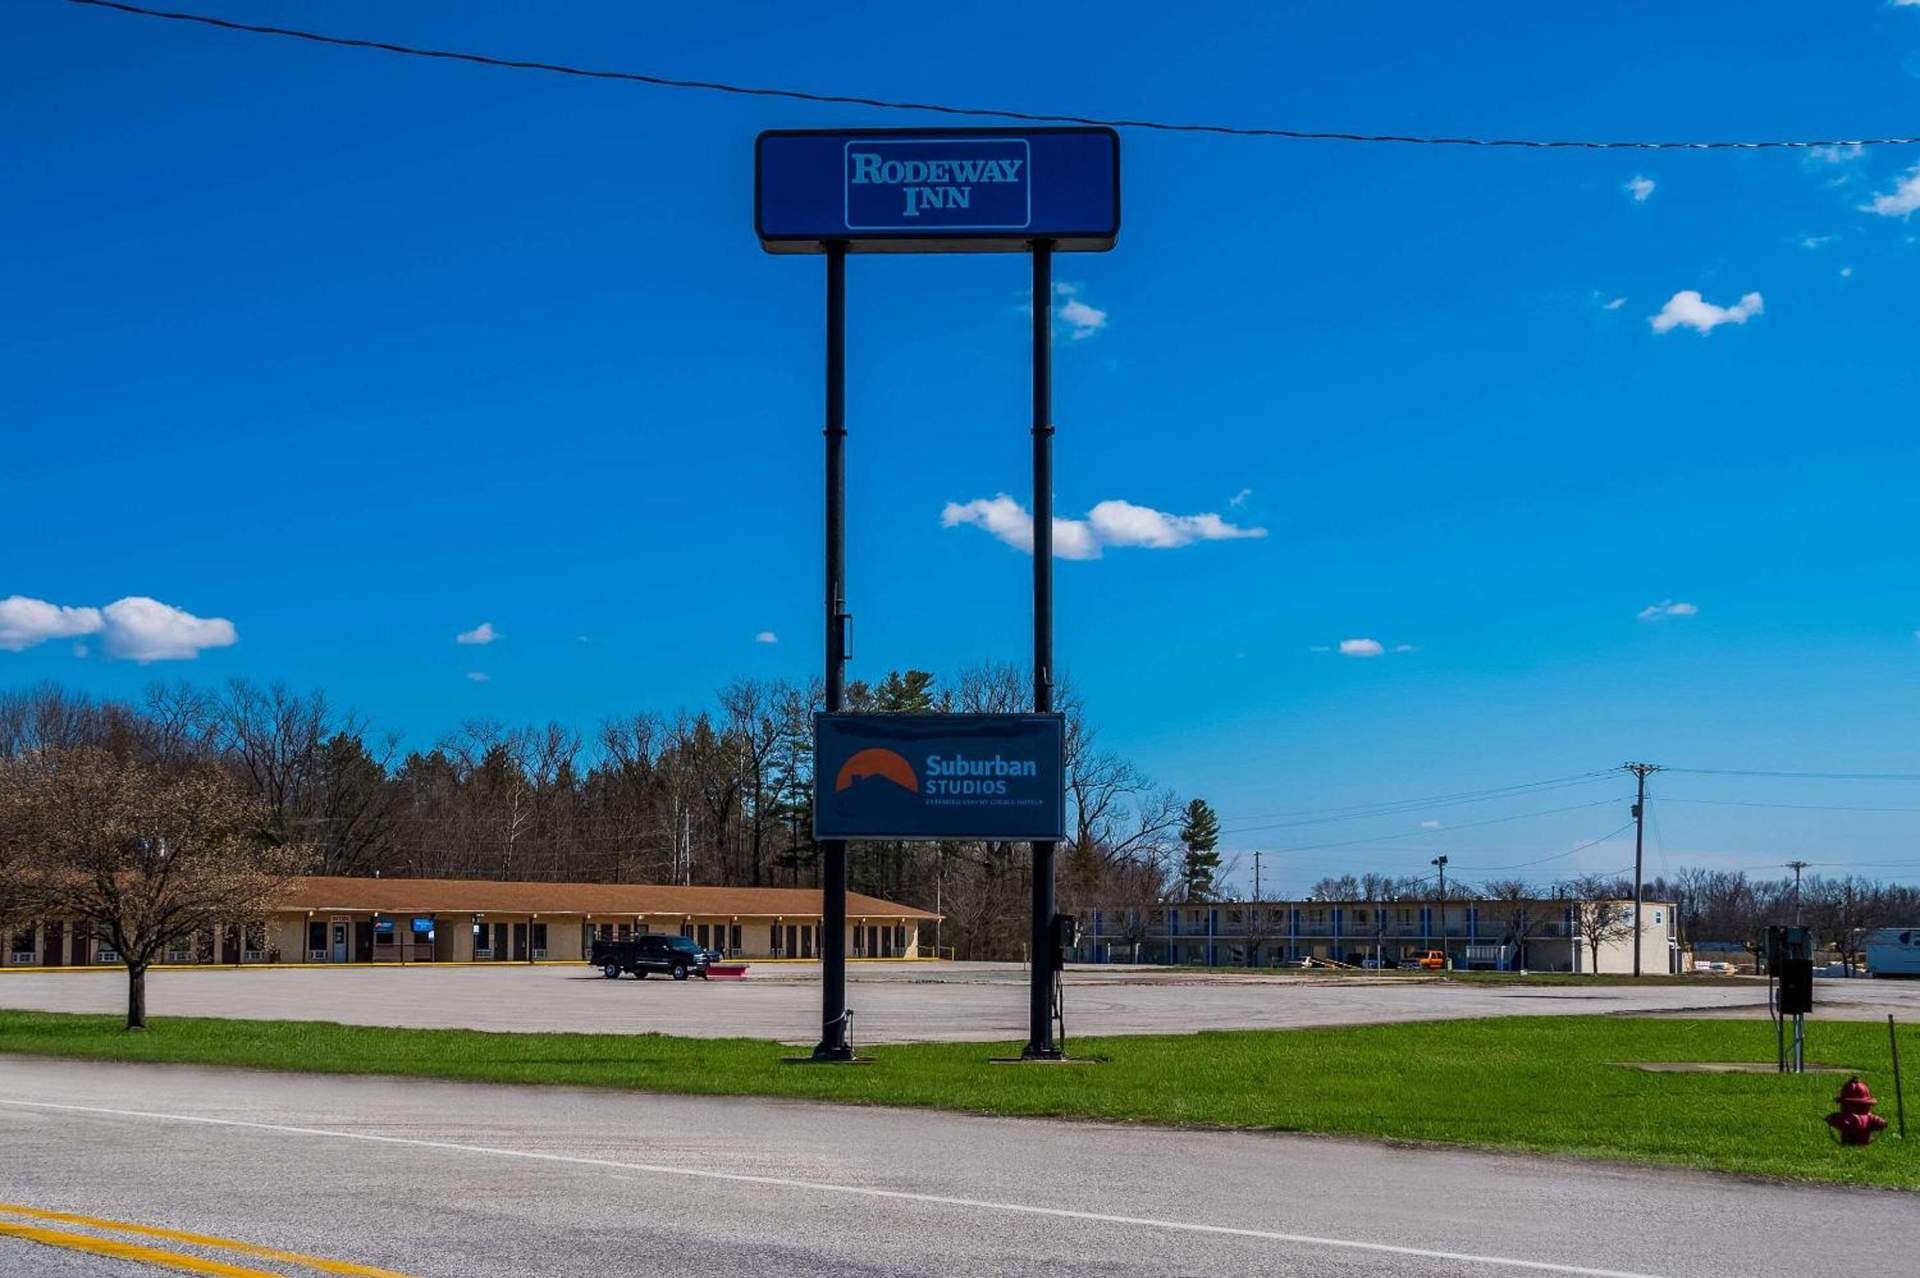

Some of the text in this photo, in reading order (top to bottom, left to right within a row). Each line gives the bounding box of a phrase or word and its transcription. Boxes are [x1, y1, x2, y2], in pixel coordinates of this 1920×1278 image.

[903, 187, 971, 215] INN
[926, 754, 1036, 776] Suburban
[926, 779, 1007, 795] STUDIOS
